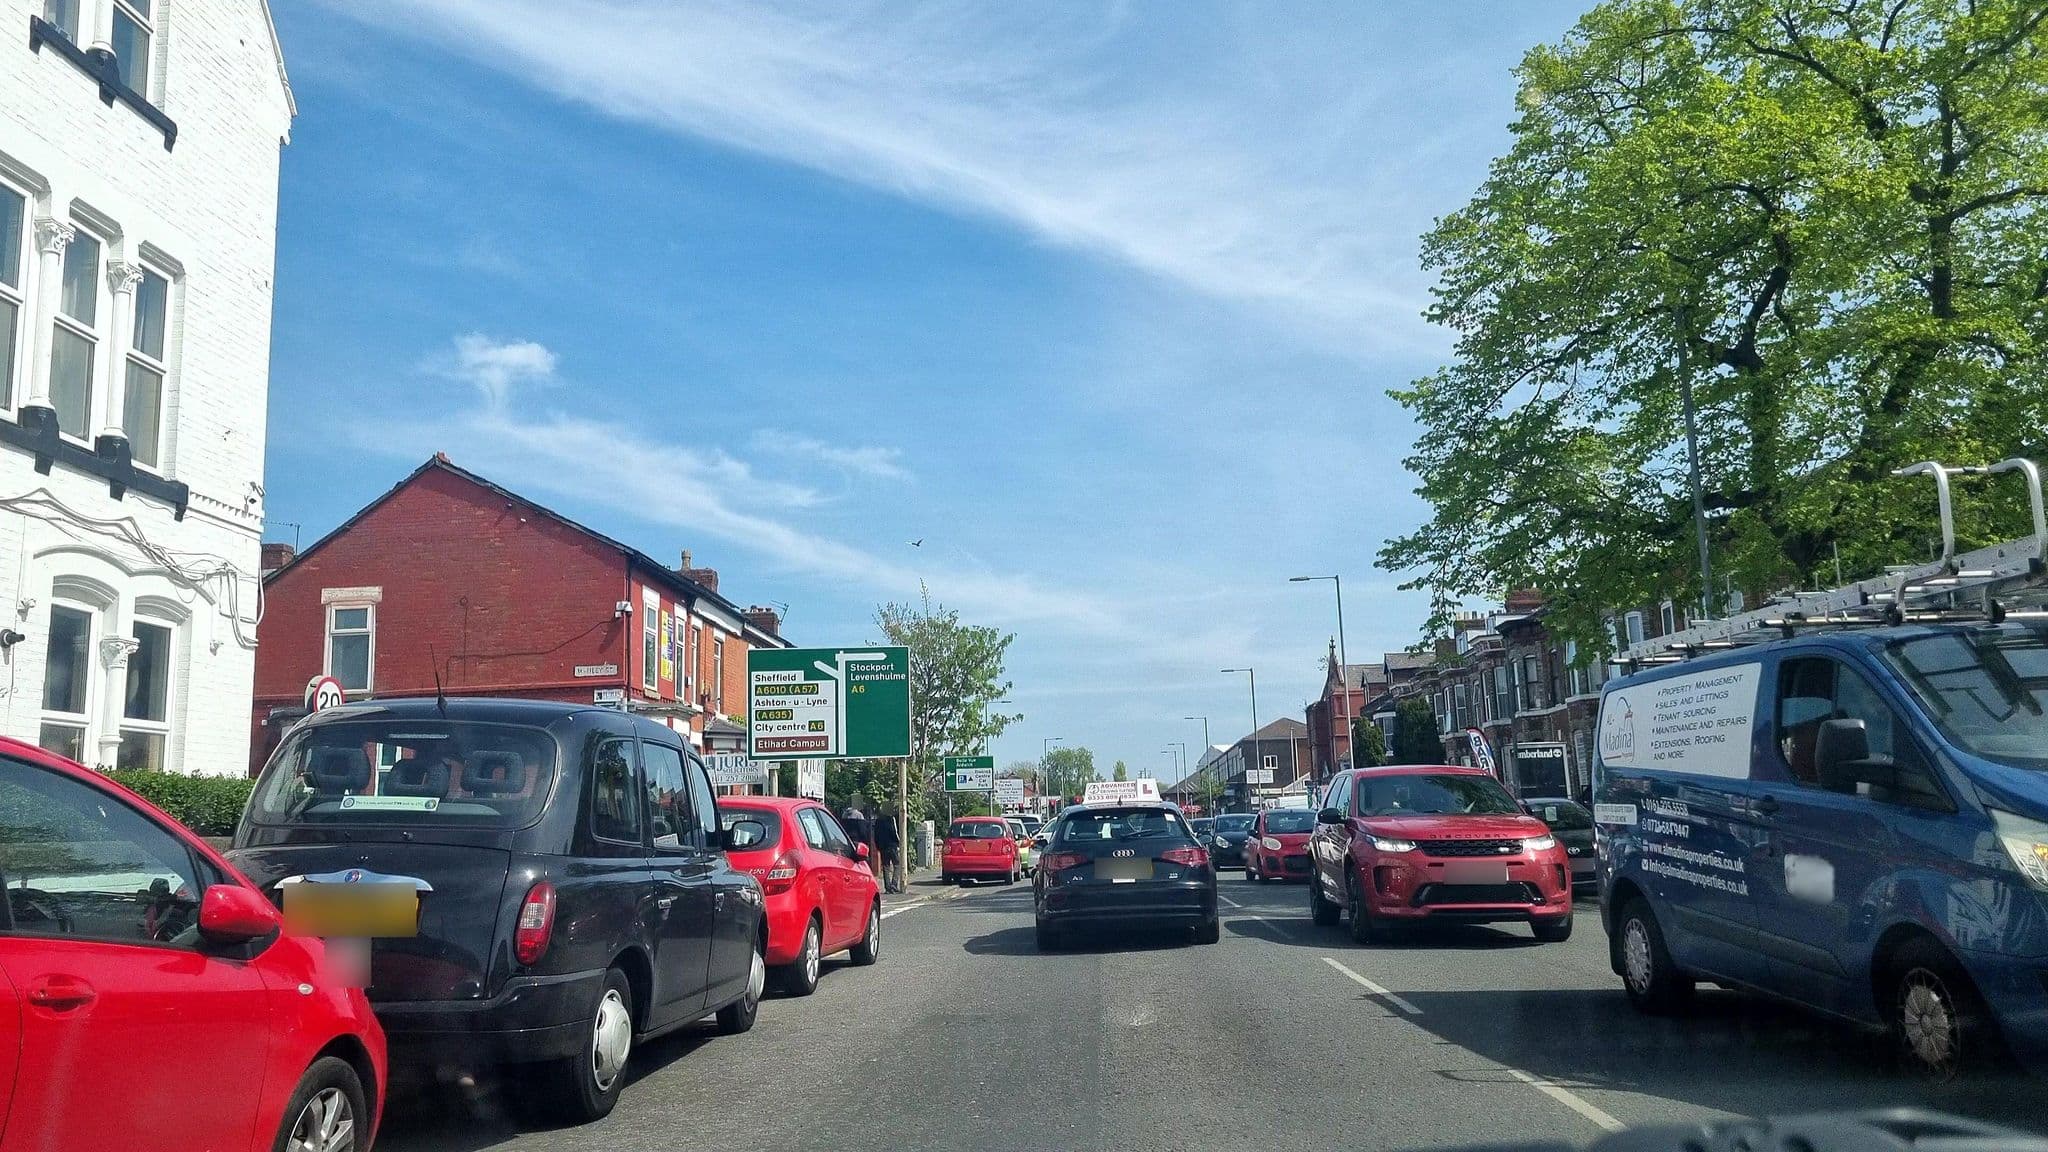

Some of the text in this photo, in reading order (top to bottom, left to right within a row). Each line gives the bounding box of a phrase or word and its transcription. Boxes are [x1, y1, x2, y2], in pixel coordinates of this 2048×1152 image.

[850, 663, 894, 673] Stockport
[755, 674, 797, 682] Sheffield
[850, 673, 906, 681] Levenshulme
[756, 686, 787, 695] A6010
[851, 685, 865, 693] A6
[1662, 674, 1743, 696] PROPERTY MANAGEMENT
[320, 691, 340, 710] 20
[1658, 691, 1729, 709] SALES AND LETTINGS
[1657, 707, 1716, 722] TENANT SOURCING
[755, 721, 824, 732] City centre A6
[1654, 716, 1747, 735] MAINTENANCE AND REPAIRS
[758, 739, 826, 749] Etihad Campus
[1695, 734, 1725, 745] ROOFING
[1653, 750, 1685, 761] AND MORE
[1142, 784, 1153, 794] L
